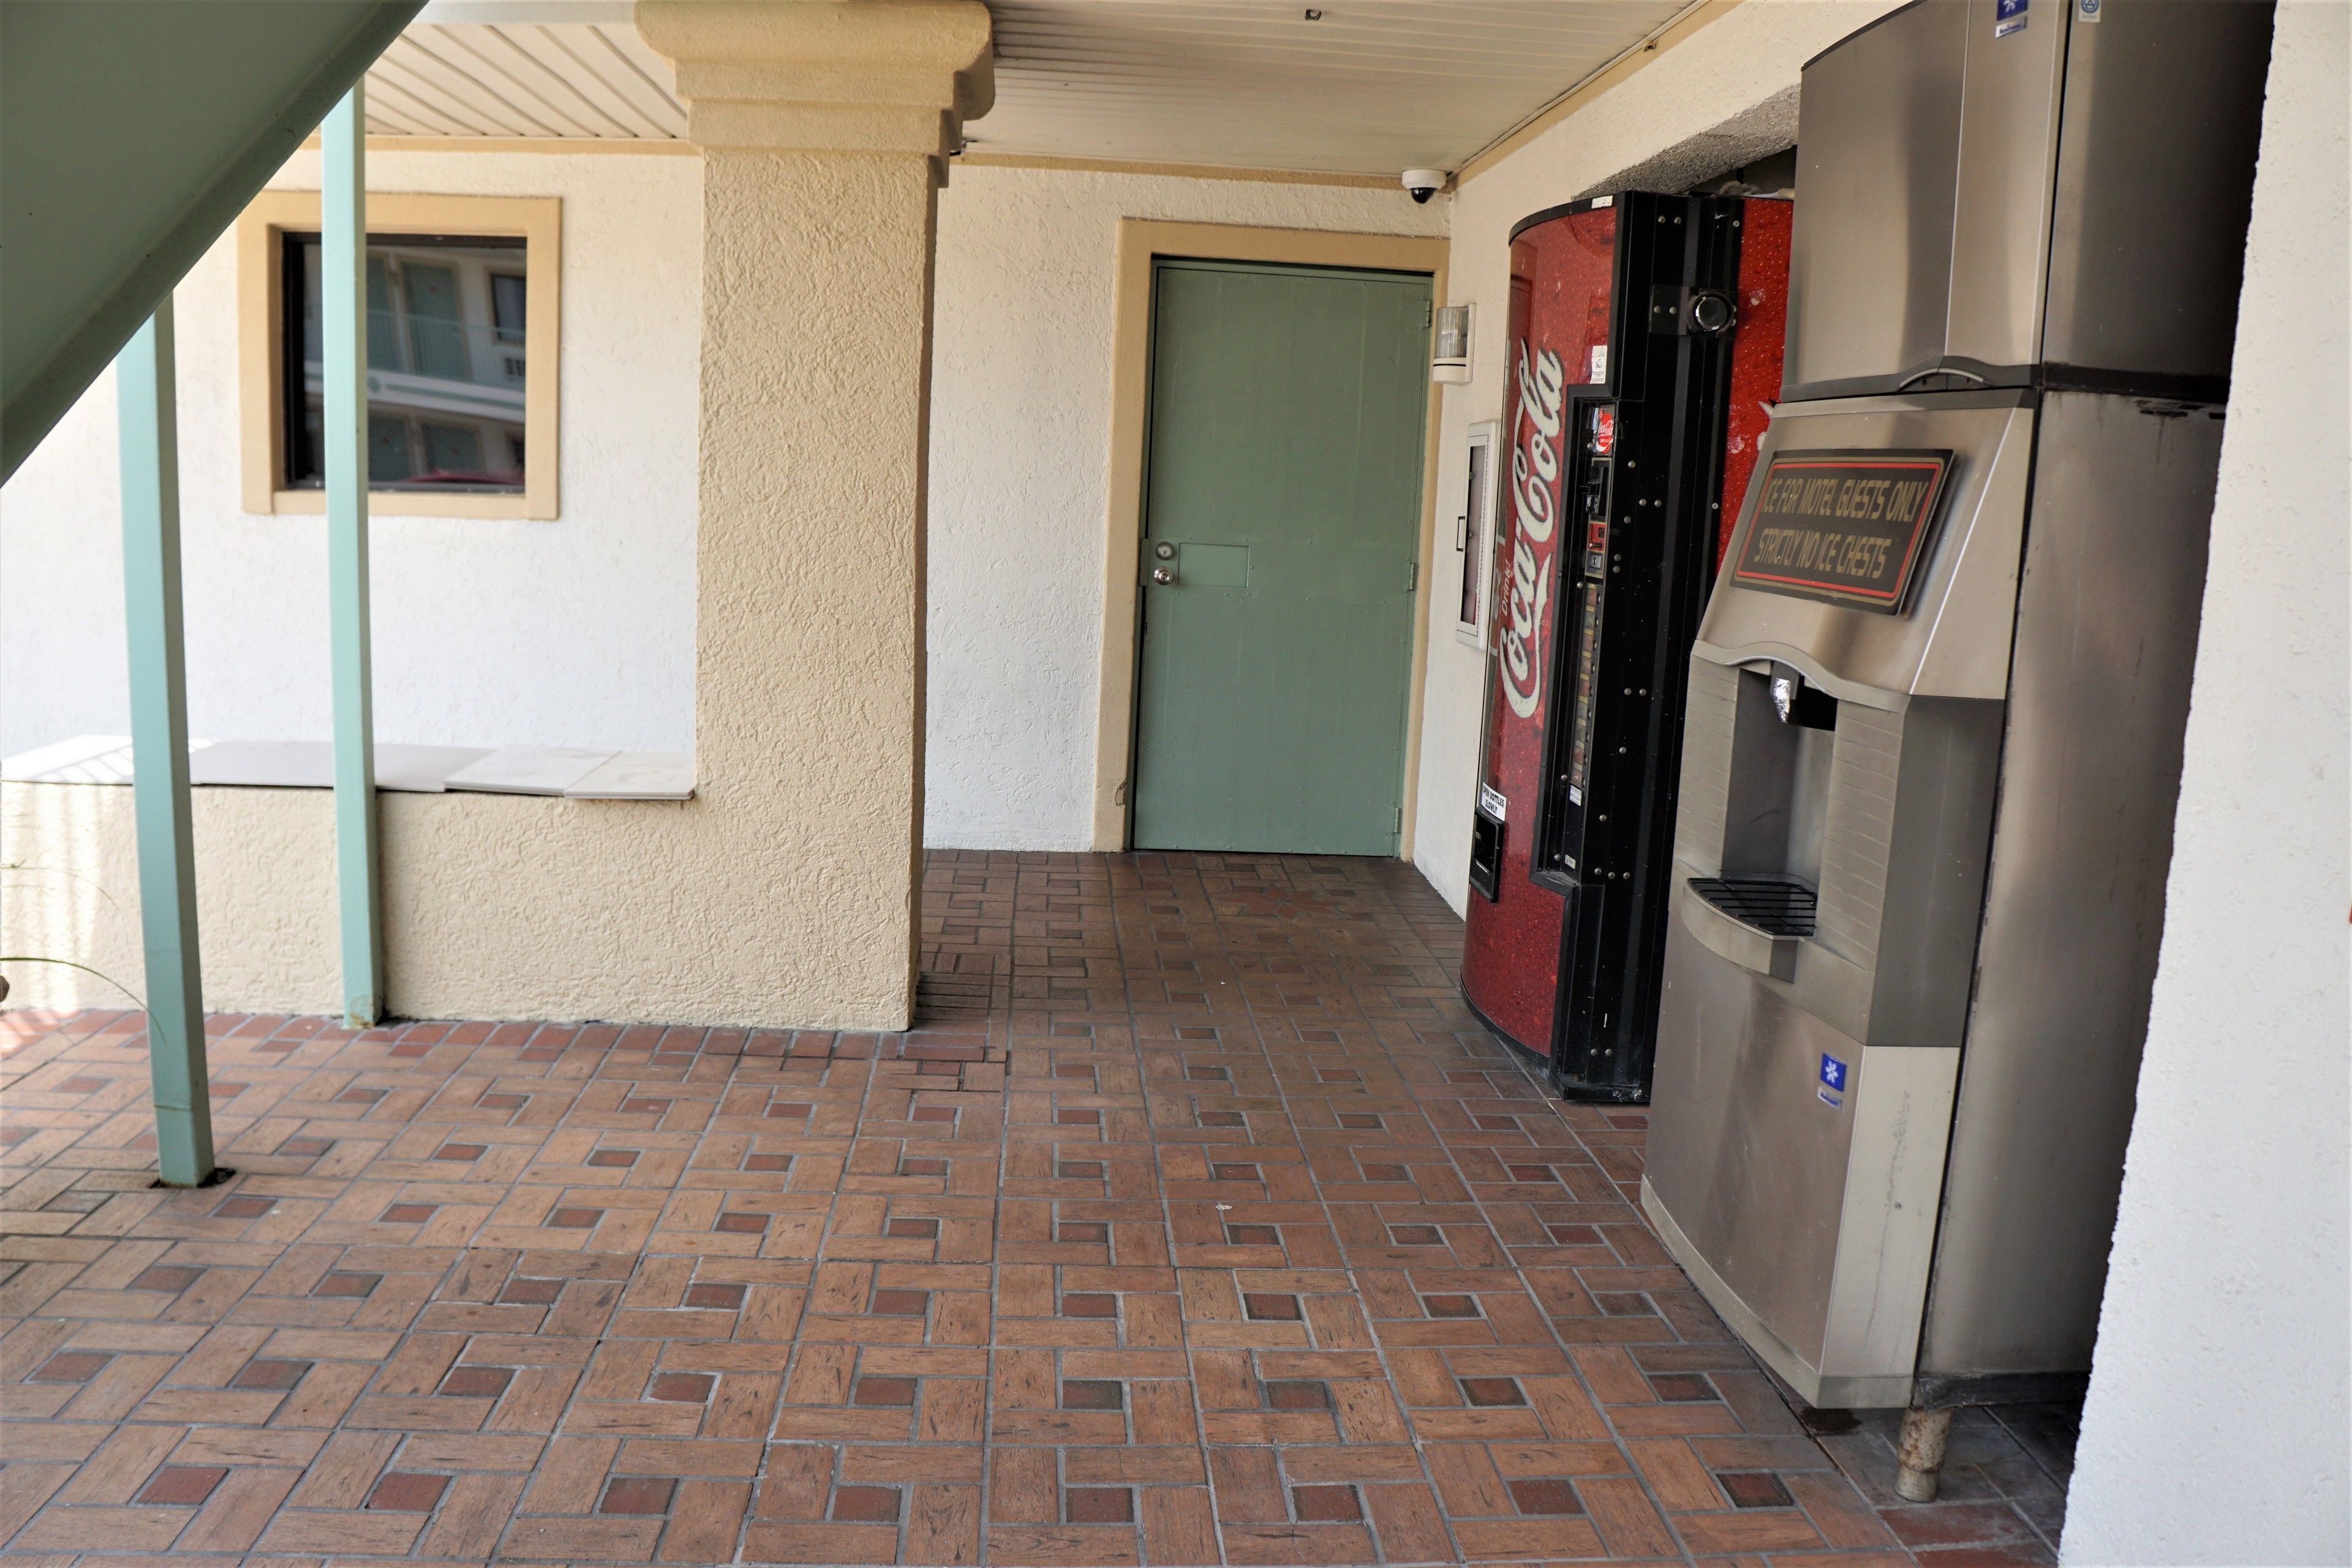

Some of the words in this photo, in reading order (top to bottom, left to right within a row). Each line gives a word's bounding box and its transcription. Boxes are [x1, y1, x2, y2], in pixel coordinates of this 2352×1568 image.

[1760, 478, 1783, 513] ICE
[1776, 478, 1803, 513] FOR
[1798, 478, 1838, 516] MOTEL
[1836, 479, 1891, 519] GUESTS
[1886, 480, 1929, 522] ONLY
[1754, 528, 1804, 567] STRICTLY
[1796, 530, 1820, 568] NO
[1814, 533, 1842, 571] ICE
[1836, 535, 1892, 579] CHESTS
